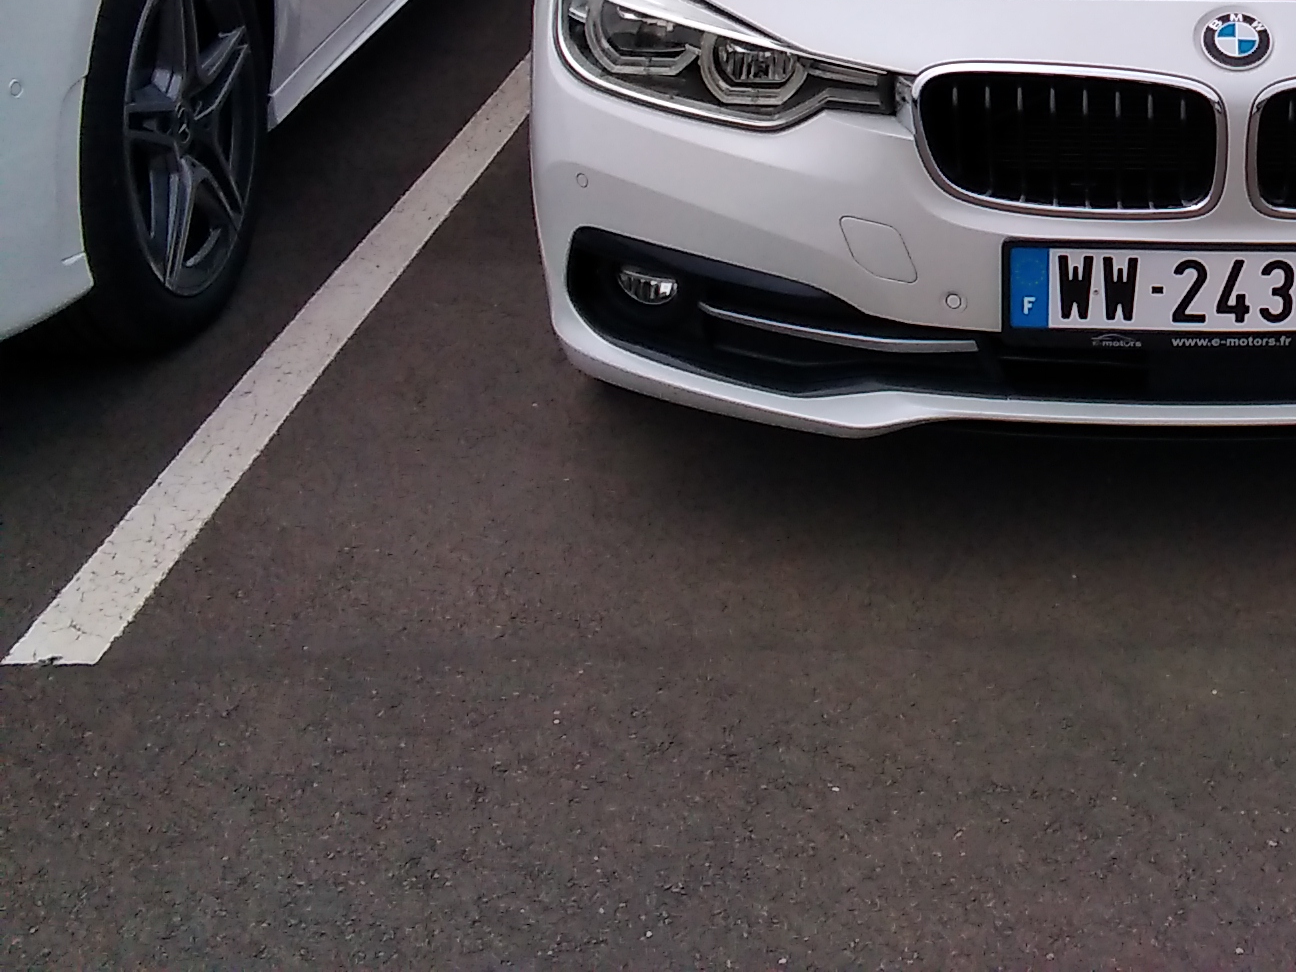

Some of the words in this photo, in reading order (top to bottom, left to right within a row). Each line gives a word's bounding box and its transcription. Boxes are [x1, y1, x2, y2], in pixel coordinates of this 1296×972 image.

[1208, 13, 1266, 31] BMW
[1022, 295, 1036, 315] F
[1171, 335, 1292, 347] www.e-motors.fr
